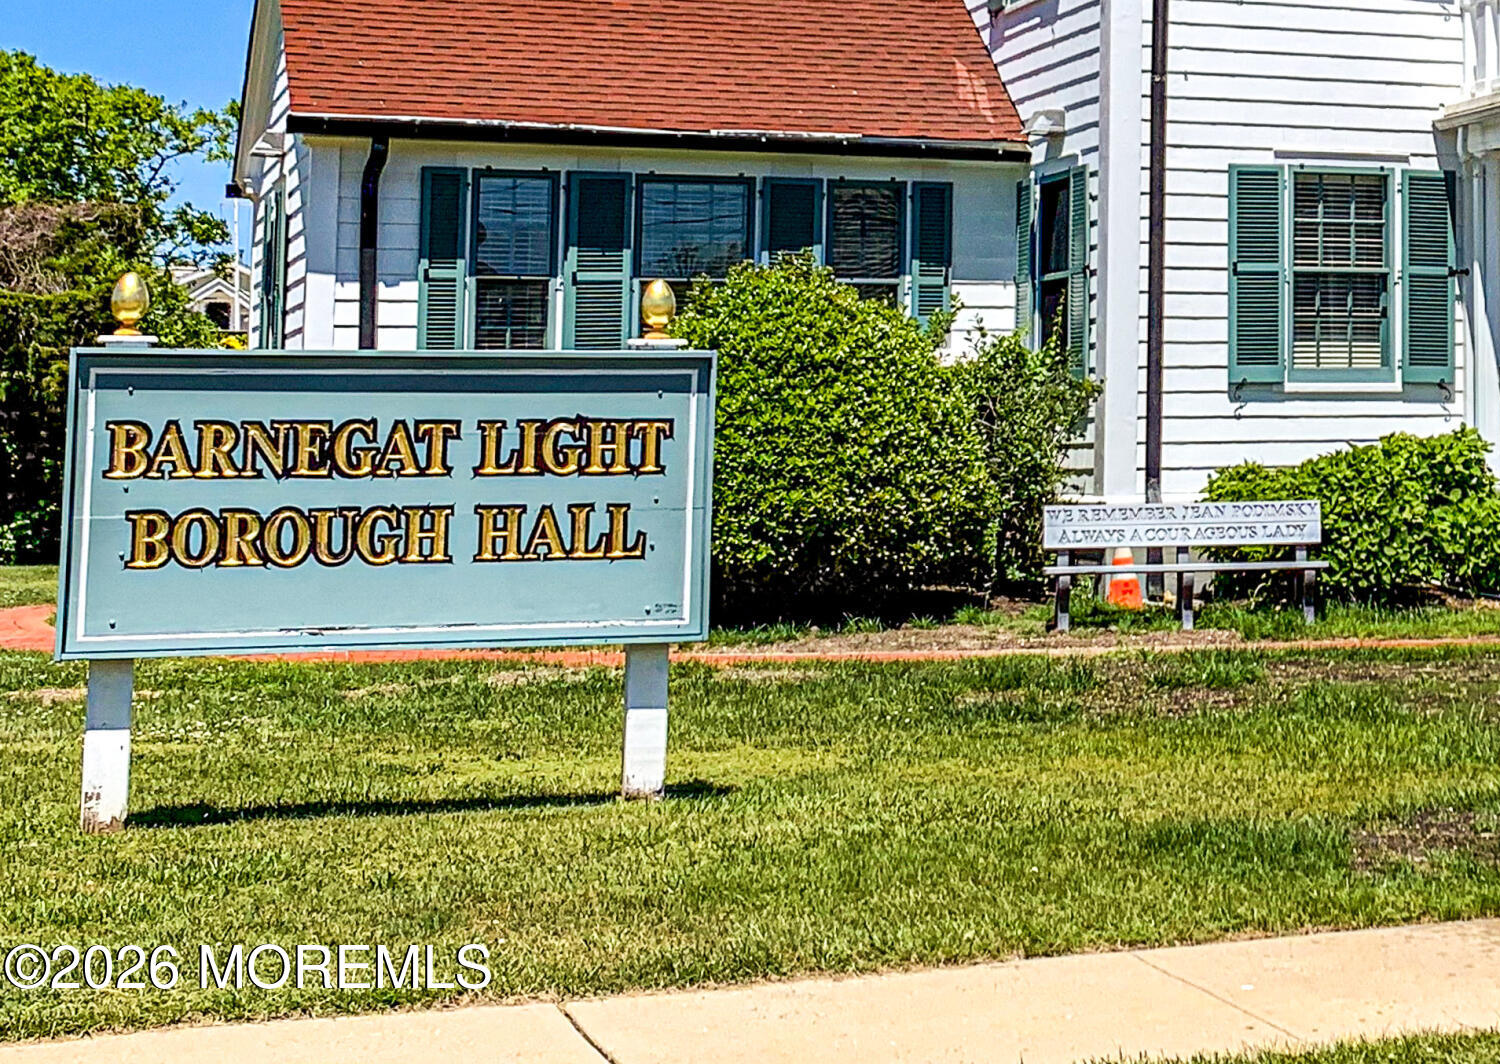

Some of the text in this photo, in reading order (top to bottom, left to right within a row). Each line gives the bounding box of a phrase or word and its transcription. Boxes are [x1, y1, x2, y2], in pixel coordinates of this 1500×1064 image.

[103, 417, 675, 479] BARNEGAT LIGHT
[1045, 508, 1073, 523] WE
[1077, 506, 1177, 522] REMEMBER
[1182, 504, 1226, 520] JEAN
[1058, 523, 1308, 544] ALWAYS A COURAGEOUS LADY
[124, 502, 647, 570] BOROUGH HALL
